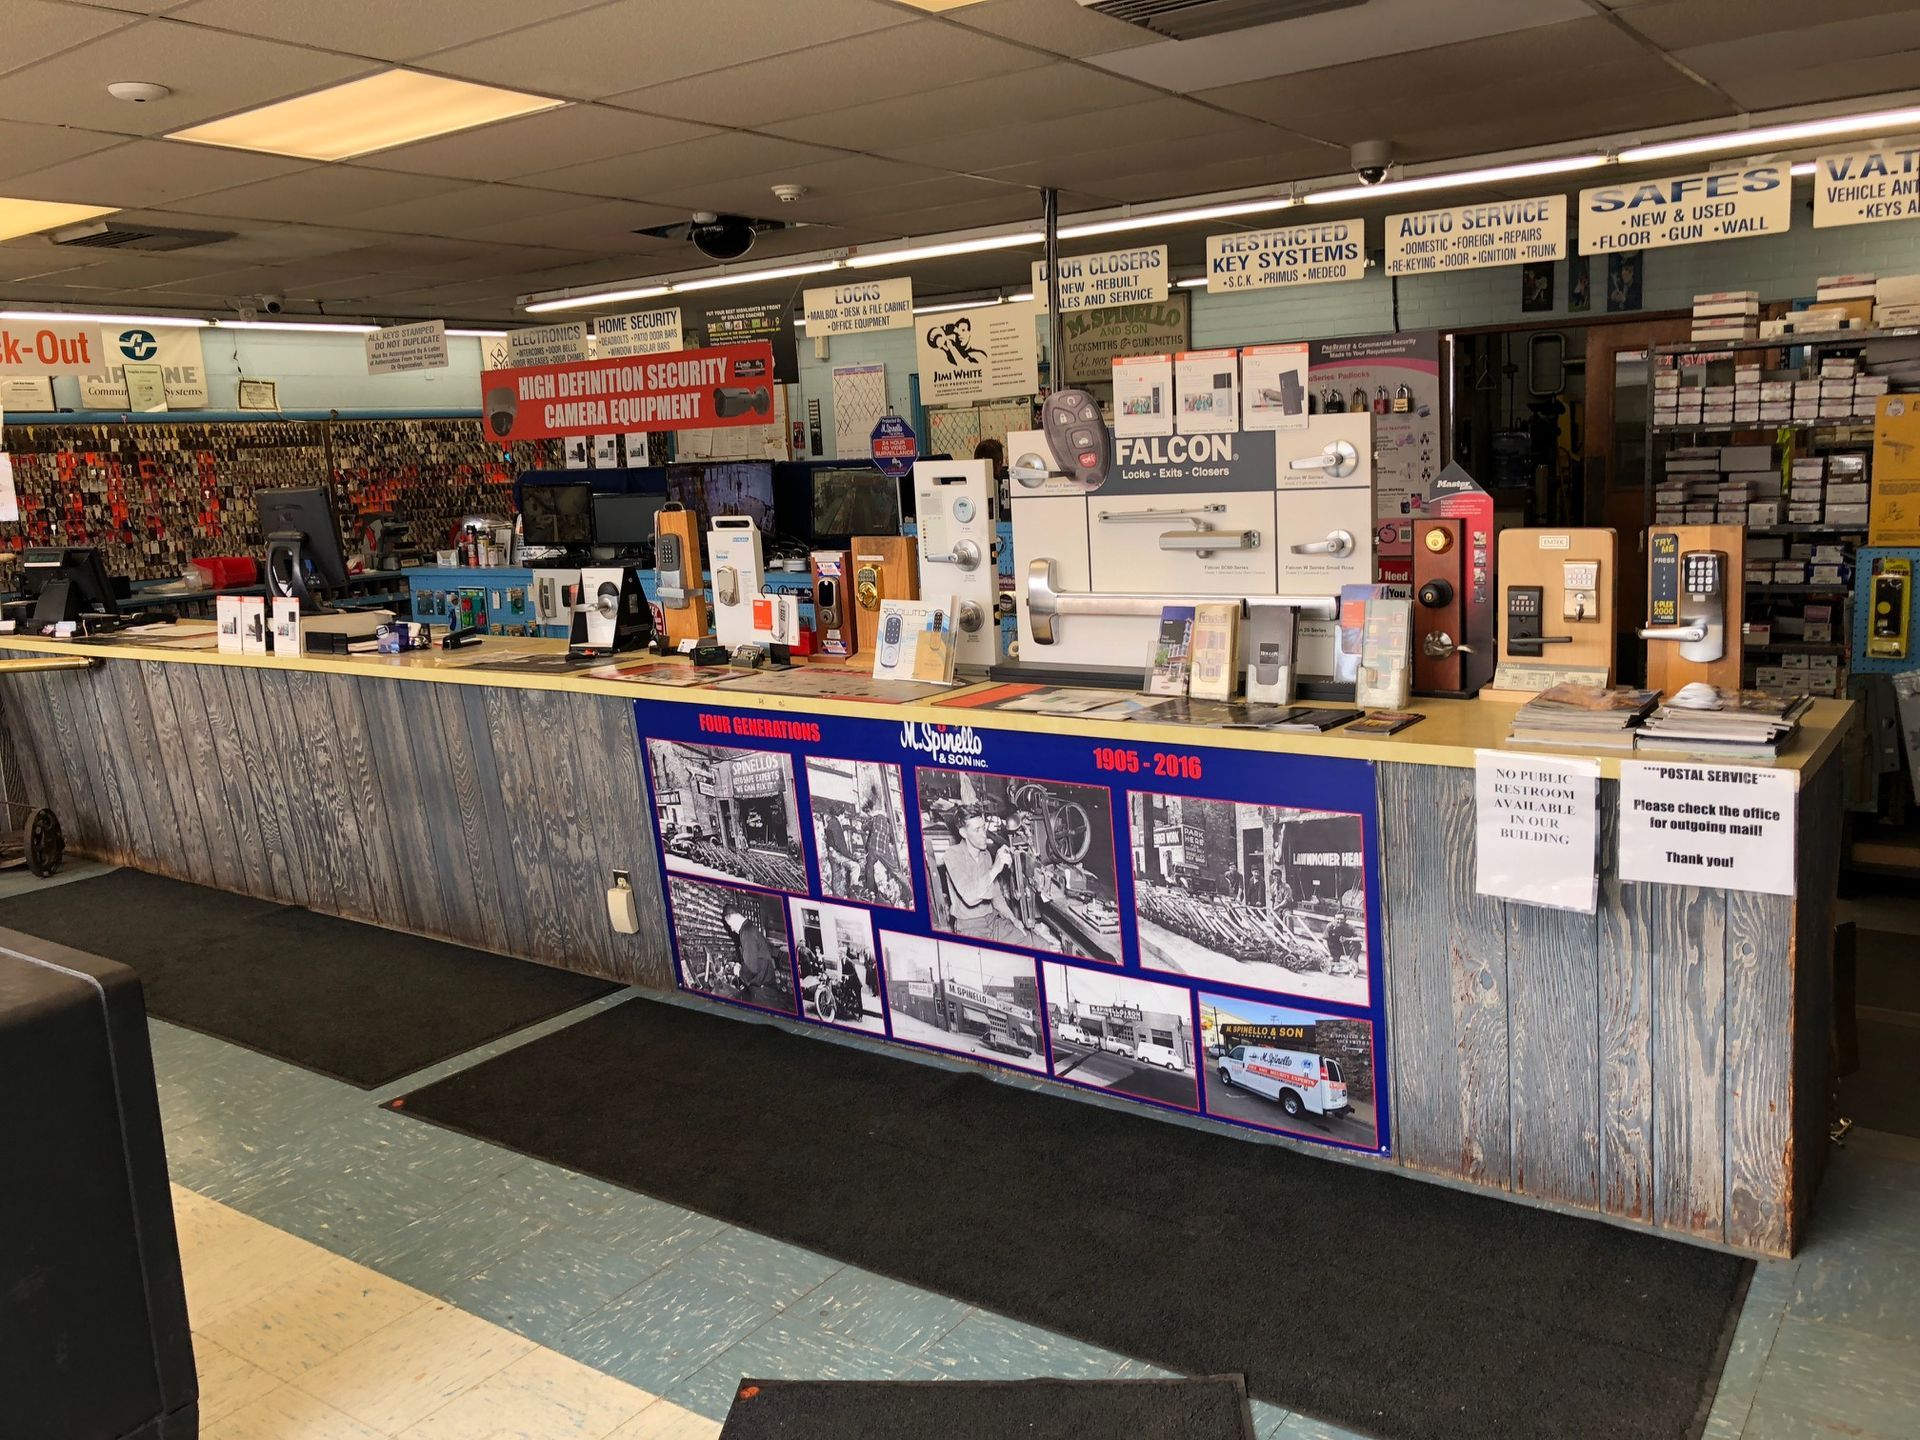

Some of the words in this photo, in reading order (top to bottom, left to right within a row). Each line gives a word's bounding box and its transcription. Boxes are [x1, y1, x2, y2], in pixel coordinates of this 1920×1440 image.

[1591, 168, 1780, 212] SAFES
[1827, 183, 1886, 203] VEHICLE
[1400, 212, 1453, 237] AUTO
[1462, 200, 1549, 230] SERVICE
[1631, 211, 1666, 228] NEW
[1674, 208, 1684, 222] &
[1692, 202, 1736, 220] USED
[1866, 201, 1901, 218] KEYS
[1221, 224, 1349, 254] RESTRICTED
[1406, 238, 1448, 255] DOMESTIC
[1457, 233, 1494, 249] FOREIGN
[1504, 228, 1542, 244] REPAIRS
[1600, 231, 1650, 249] FLOOR
[1669, 224, 1703, 241] GUN
[1722, 216, 1768, 234] WALL
[1089, 250, 1161, 276] CLOSERS
[1213, 255, 1249, 273] KEY
[1258, 243, 1358, 269] SYSTEMS
[1392, 256, 1436, 272] RE-KEYING
[1445, 252, 1469, 266] DOOR
[1478, 247, 1516, 263] IGNITION
[1526, 243, 1557, 258] TRUNK
[1062, 282, 1085, 295] NEW
[1096, 275, 1139, 291] REBUILT
[1228, 274, 1254, 288] S.C.K.
[1263, 269, 1299, 284] PRIMUS
[1308, 264, 1346, 280] MEDECO
[835, 284, 880, 305] LOCKS
[1084, 293, 1106, 306] AND
[1110, 287, 1153, 303] SERVICE
[810, 309, 838, 320] MAILBOX
[844, 306, 860, 317] DESK
[869, 304, 882, 314] FILE
[884, 300, 910, 313] CABINET
[599, 317, 627, 334] HOME
[631, 310, 677, 330] SECURITY
[831, 319, 853, 331] OFFICE
[855, 316, 890, 329] EQUIPMENT
[1100, 325, 1121, 338] AND
[1125, 323, 1148, 335] SON
[368, 334, 379, 342] ALL
[383, 330, 399, 340] KEYS
[401, 325, 434, 338] STAMPED
[374, 341, 384, 350] DO
[386, 340, 401, 348] NOT
[402, 334, 440, 347] DUPLICATE
[512, 326, 581, 346] ELECTRONICS
[601, 334, 629, 346] DEADBOLTS
[649, 330, 664, 341] DOOR
[665, 329, 678, 339] BARS
[0, 329, 91, 365] k-Out
[610, 345, 632, 356] WINDOW
[657, 341, 671, 351] BARS
[1068, 338, 1118, 353] LOCKSMITHS
[1132, 334, 1184, 348] GUNSMITHS
[518, 374, 555, 400] HIGH
[558, 365, 643, 398] DEFINITION
[647, 357, 728, 389] SECURITY
[934, 371, 952, 383] JIMI
[953, 369, 982, 380] WHITE
[1338, 371, 1370, 380] Padlocks
[544, 400, 607, 429] CAMERA
[610, 393, 701, 425] EQUIPMENT
[1115, 434, 1232, 466] FALCON
[1122, 469, 1151, 480] Locks
[1159, 468, 1182, 478] Exits
[1192, 466, 1230, 477] Closers
[1437, 479, 1471, 488] Master
[1654, 537, 1672, 547] TRY
[1661, 544, 1674, 554] ME
[1385, 570, 1408, 581] Need
[1389, 588, 1406, 598] You
[699, 713, 731, 733] FOUR
[733, 716, 820, 743] GENERATIONS
[732, 754, 779, 776] SPINELLOS
[939, 753, 947, 764] &
[948, 754, 972, 766] SON
[973, 759, 988, 768] INC.
[1093, 747, 1139, 773] 1905
[1153, 753, 1202, 779] 2016
[1496, 768, 1517, 780] NO
[1520, 771, 1573, 785] PUBLIC
[1494, 783, 1575, 800] RESTROOM
[1494, 798, 1576, 816] AVAILABLE
[1633, 798, 1675, 814] Please
[1677, 802, 1716, 817] check
[1719, 805, 1740, 819] the
[1742, 805, 1781, 822] office
[1509, 814, 1525, 826] IN
[1529, 815, 1560, 829] OUR
[1650, 816, 1669, 829] for
[1670, 818, 1727, 837] outgoing
[1729, 823, 1763, 837] mail!
[1184, 828, 1204, 839] PARK
[1184, 836, 1205, 846] HERE
[1500, 828, 1570, 846] BUILDING
[1293, 852, 1340, 867] LAWNMOWER
[1666, 851, 1704, 867] Thank
[1706, 854, 1734, 869] you!
[957, 988, 987, 1004] SPINELLO
[1232, 1025, 1268, 1036] SPINELLO
[1270, 1027, 1277, 1036] &
[1279, 1027, 1304, 1038] SON
